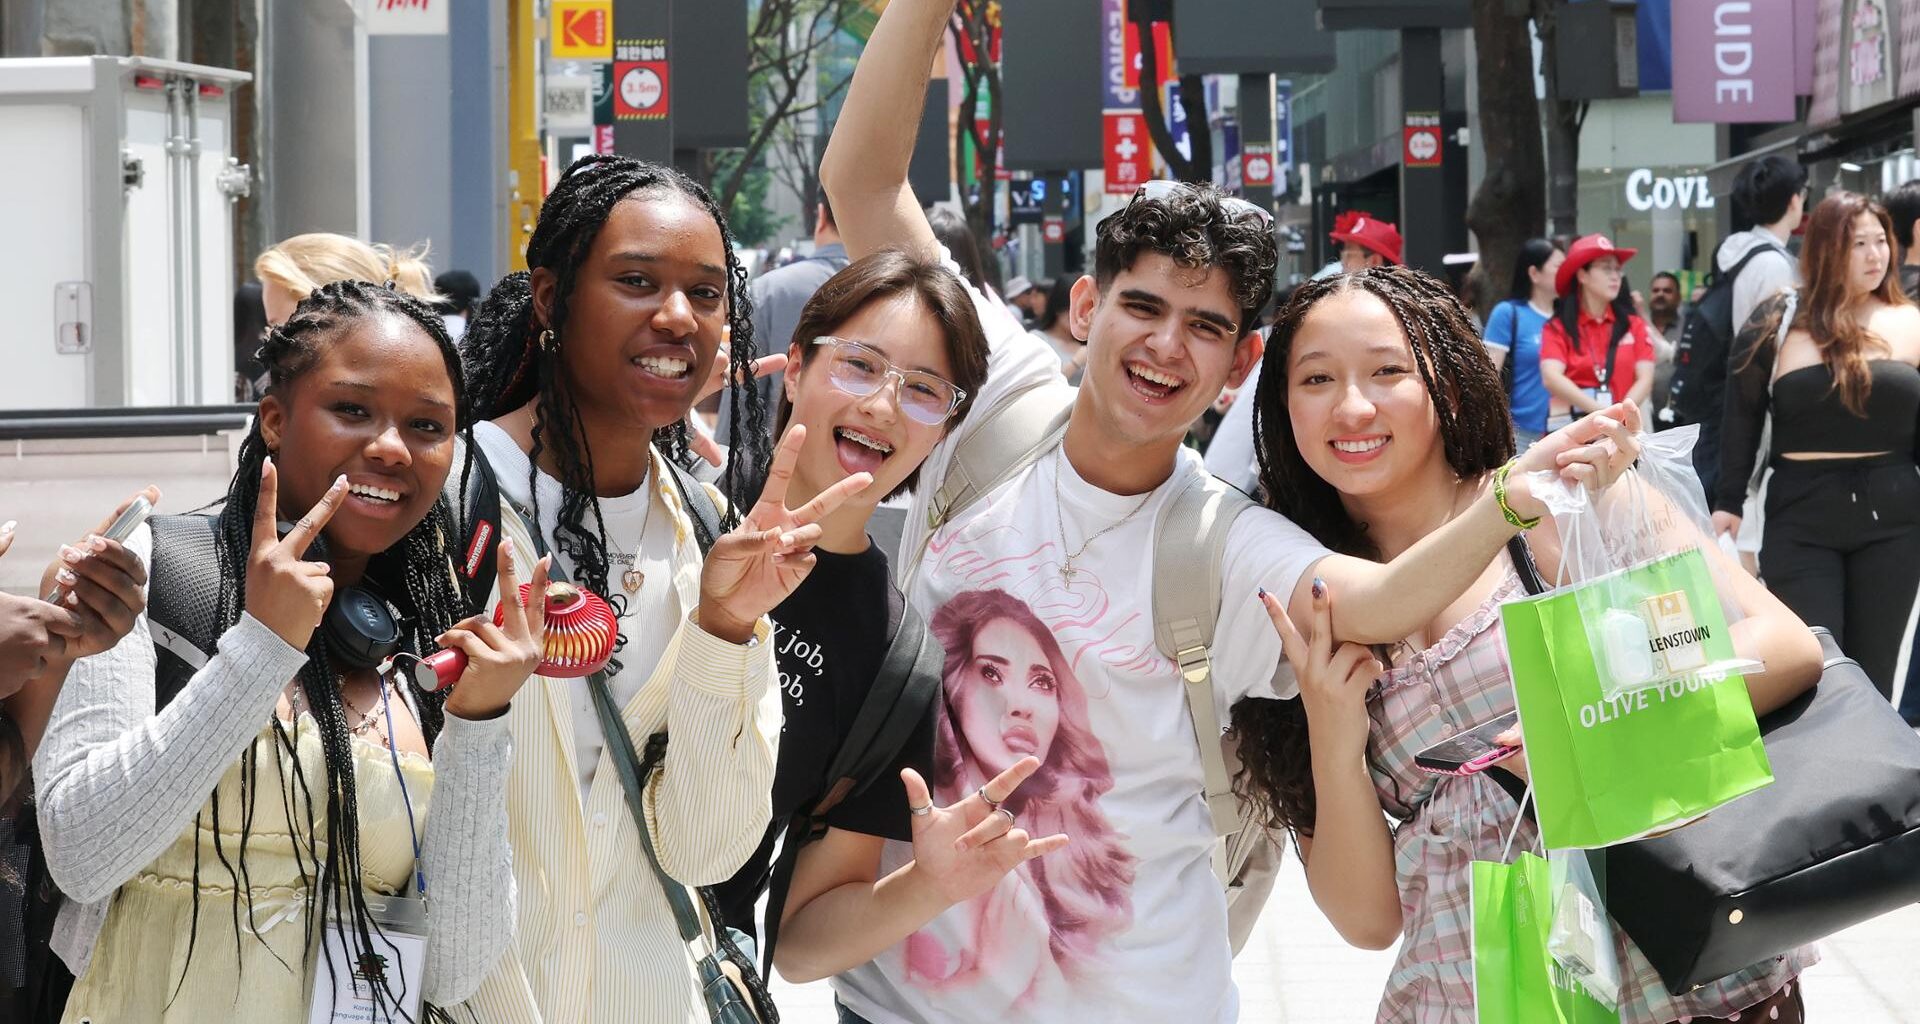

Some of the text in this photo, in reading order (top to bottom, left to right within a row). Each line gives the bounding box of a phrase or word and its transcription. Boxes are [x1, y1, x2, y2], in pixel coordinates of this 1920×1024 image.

[1713, 2, 1753, 104] UDE
[626, 83, 660, 93] 3.5m
[779, 629, 824, 676] job,
[1649, 625, 1711, 653] LENSTOWN
[776, 661, 804, 706] ob,
[1580, 690, 1649, 728] OLIVE
[332, 1011, 365, 1020] anguage
